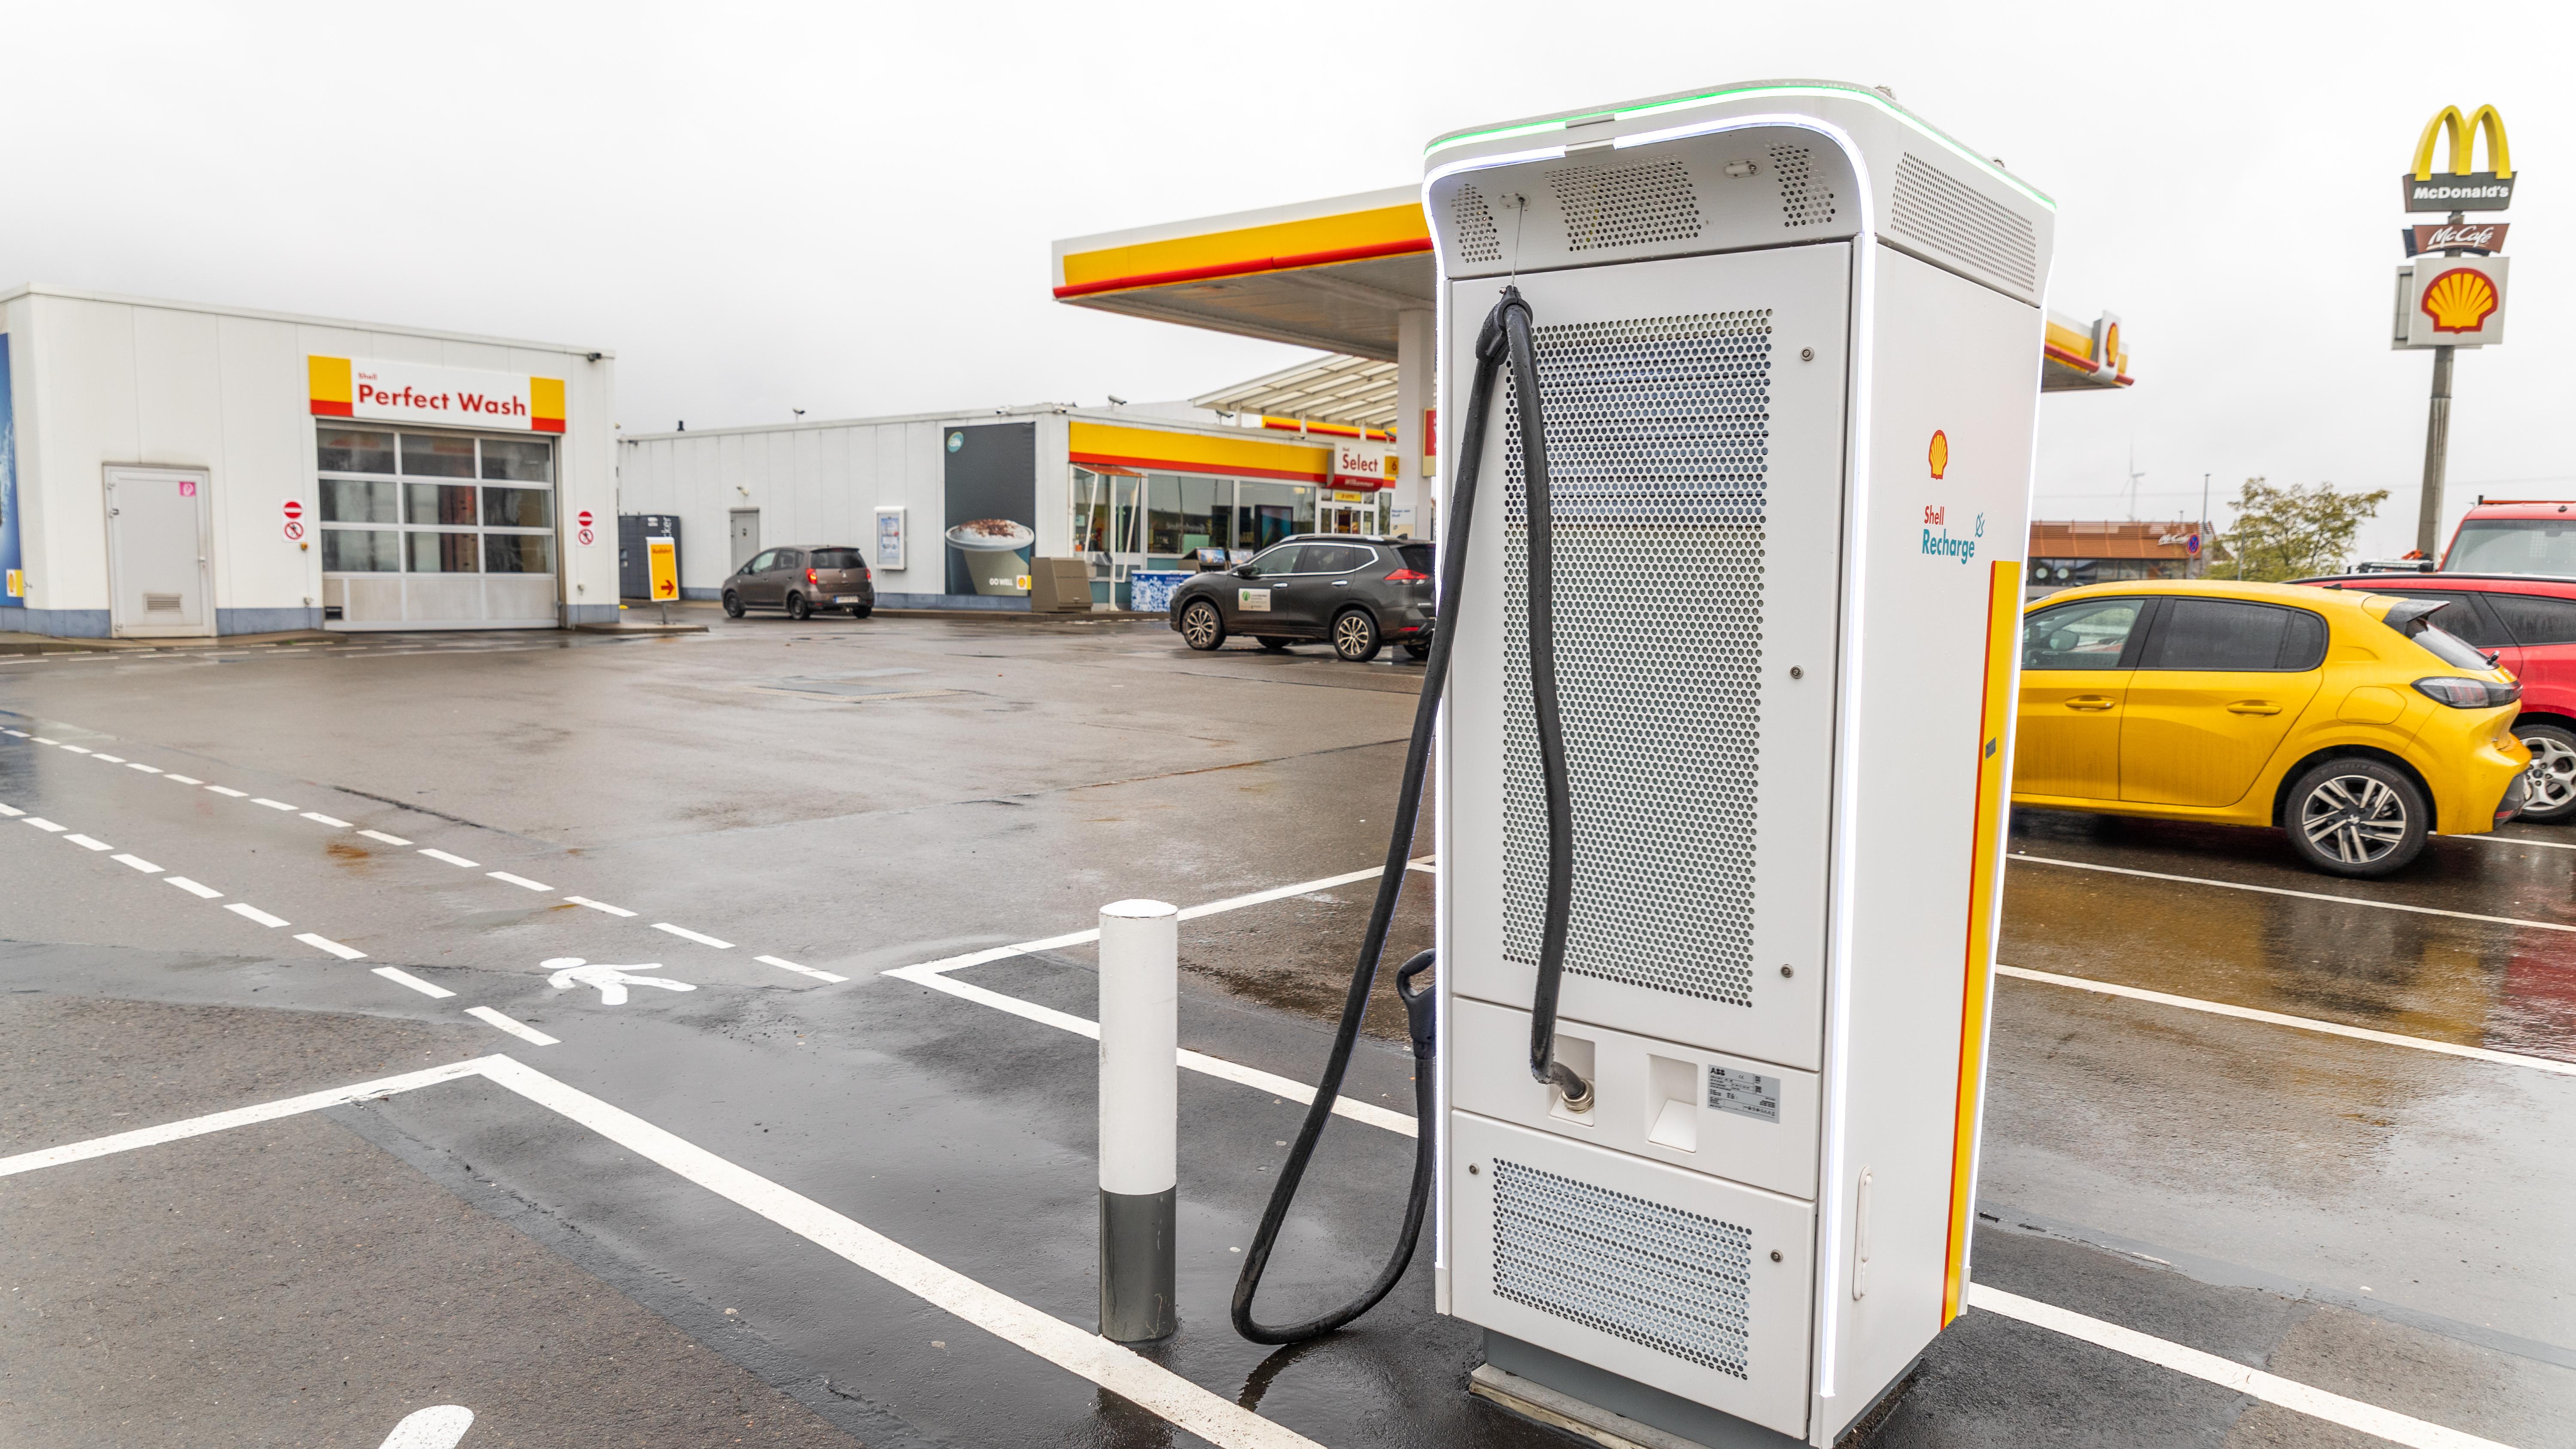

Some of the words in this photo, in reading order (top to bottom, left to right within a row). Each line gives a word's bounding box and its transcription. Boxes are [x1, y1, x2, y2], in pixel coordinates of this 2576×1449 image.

[2413, 185, 2509, 199] McDonald's
[359, 384, 449, 410] Perfect
[458, 392, 526, 416] Wash
[1343, 453, 1378, 472] Select
[1392, 462, 1397, 471] 6
[1924, 505, 1944, 525] Shell
[1922, 529, 1975, 565] Recharge
[989, 577, 999, 586] GO
[1710, 1067, 1725, 1076] ABB
